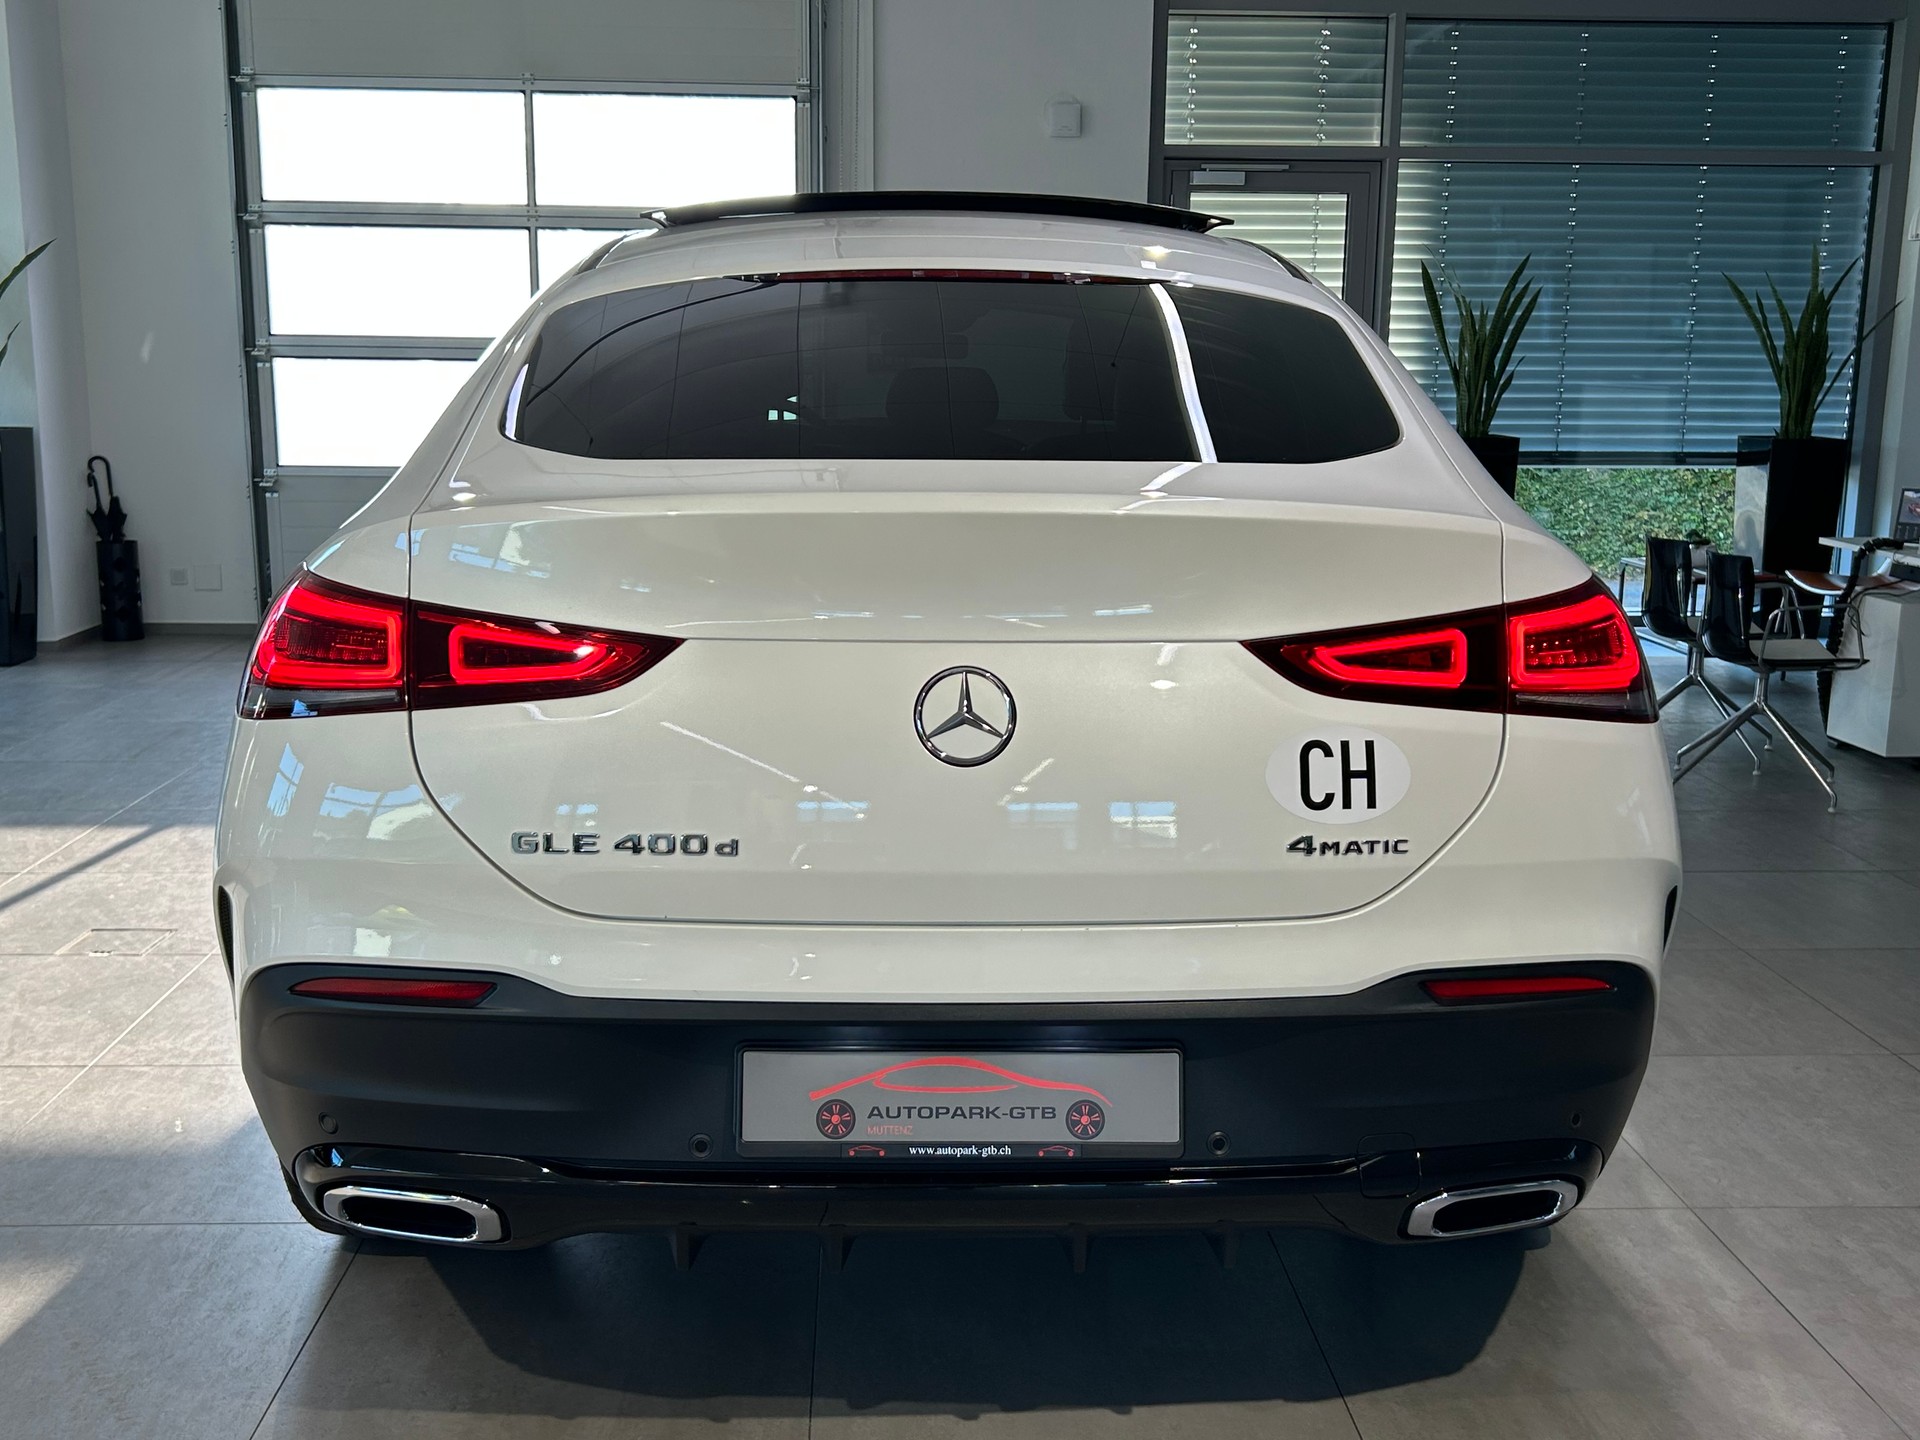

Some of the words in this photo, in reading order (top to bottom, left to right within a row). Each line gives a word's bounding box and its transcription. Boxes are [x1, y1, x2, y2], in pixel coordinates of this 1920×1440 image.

[1299, 739, 1377, 811] CH
[511, 831, 600, 855] GLE
[1286, 835, 1410, 857] 4MATIC
[867, 1106, 1057, 1119] AUTOPARK-GTB
[867, 1125, 914, 1136] MUTTENZ
[909, 1145, 1012, 1157] www.autopark-gtb.ch
